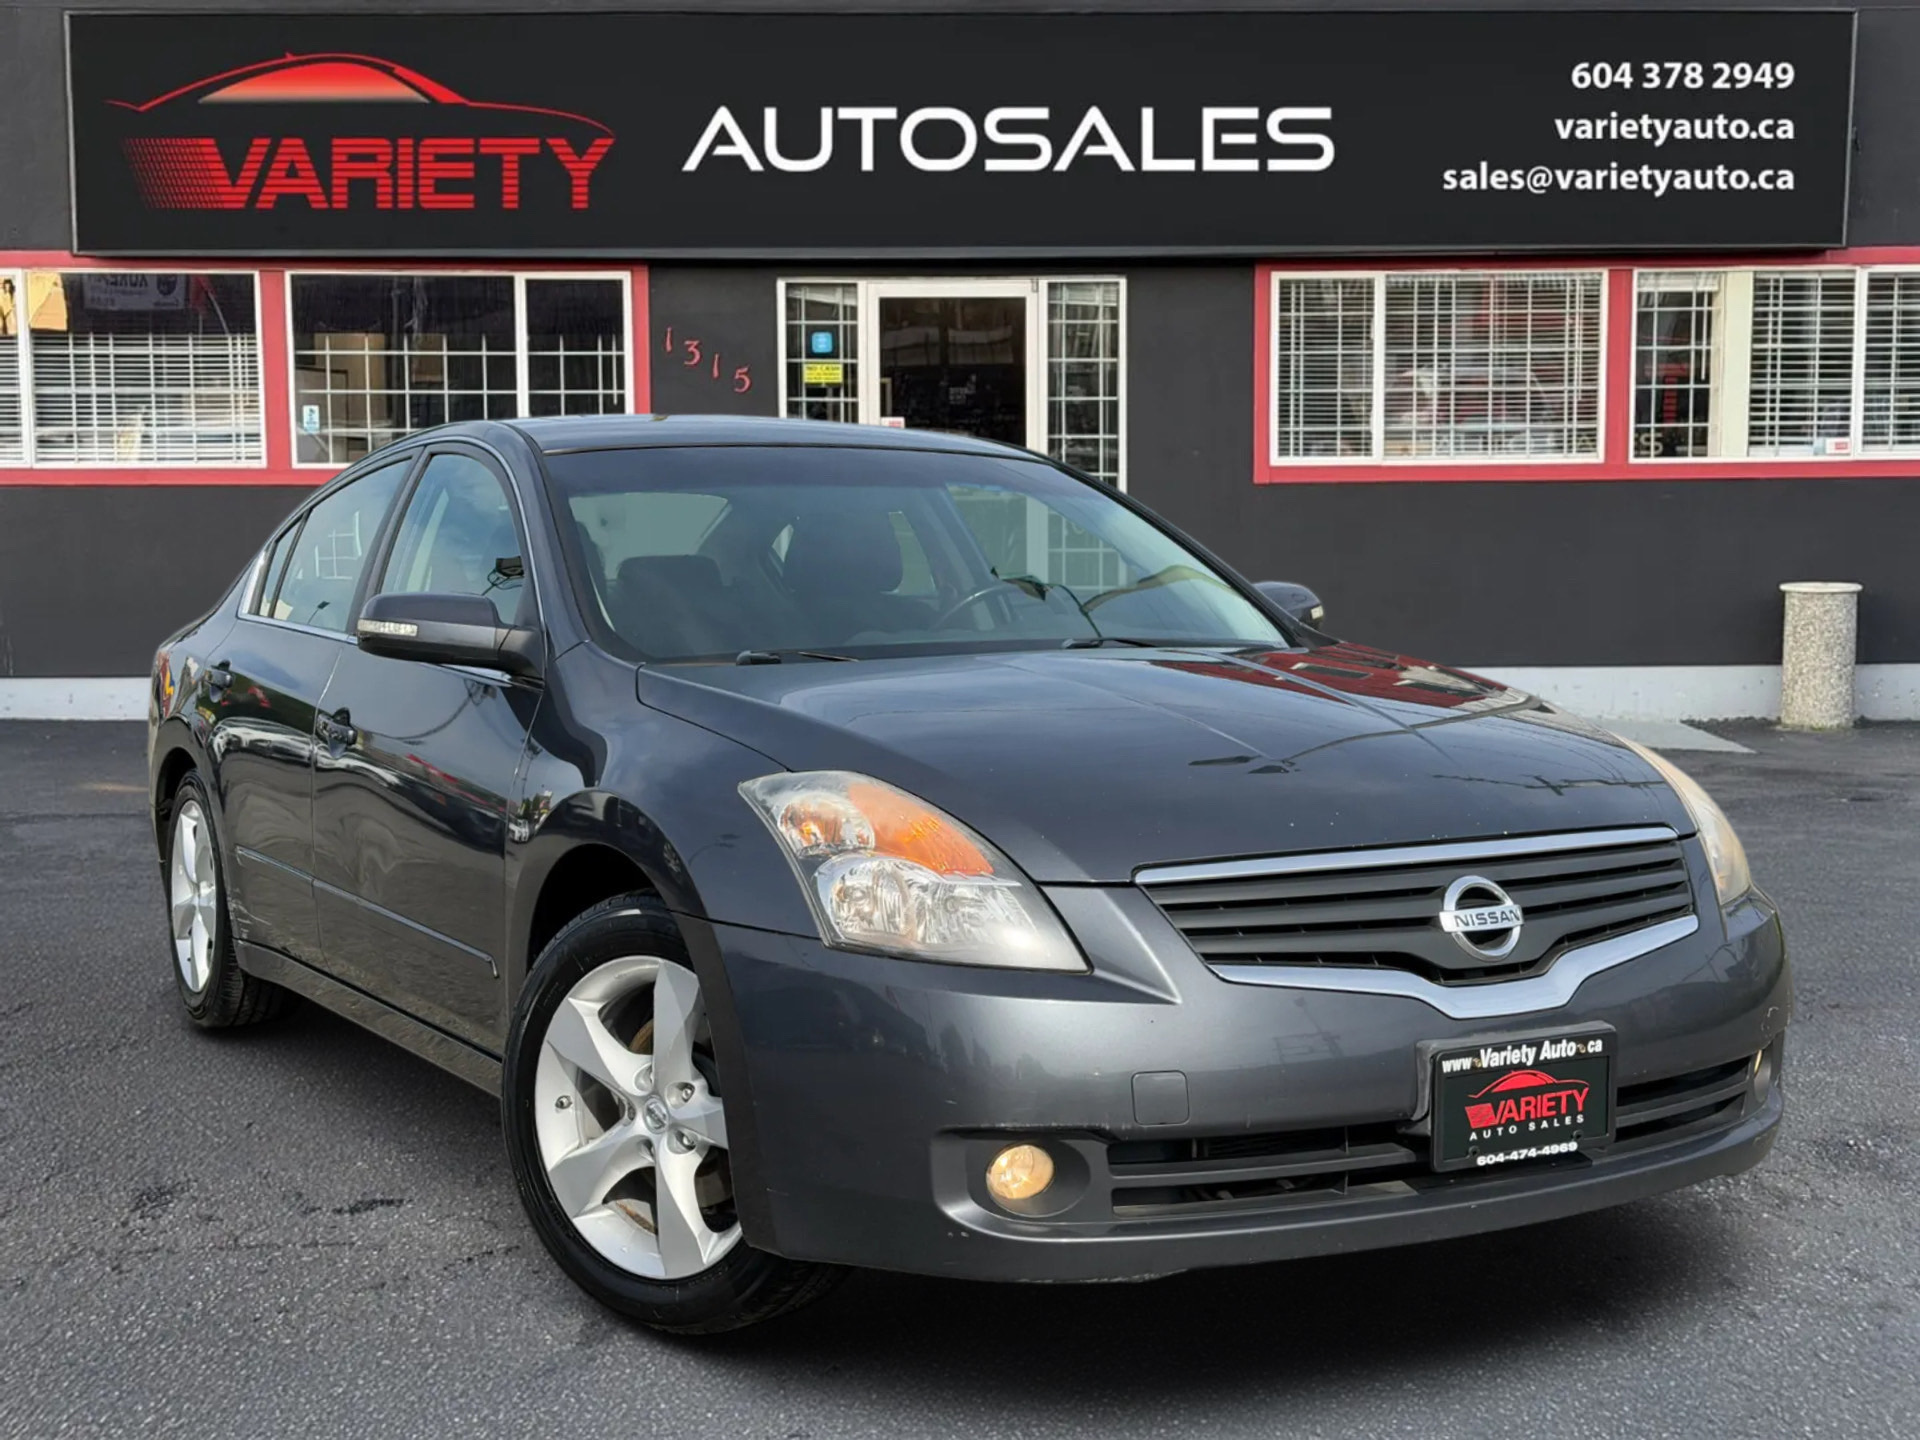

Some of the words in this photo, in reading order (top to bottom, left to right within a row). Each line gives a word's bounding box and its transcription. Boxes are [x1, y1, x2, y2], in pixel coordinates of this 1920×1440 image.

[1571, 61, 1634, 89] 604
[1642, 62, 1704, 89] 378
[1711, 62, 1795, 89] 2949
[681, 105, 1335, 172] AUTOSALES
[1554, 111, 1795, 147] varietyauto.ca
[122, 136, 615, 210] VARIETY
[1443, 160, 1795, 198] sales@varietyauto.ca
[1453, 909, 1521, 928] NISSAN
[1465, 1087, 1590, 1129] VARIETY
[1469, 1124, 1518, 1141] AUTO
[1528, 1114, 1584, 1131] SALES
[1476, 1141, 1578, 1167] 604-474-4969
